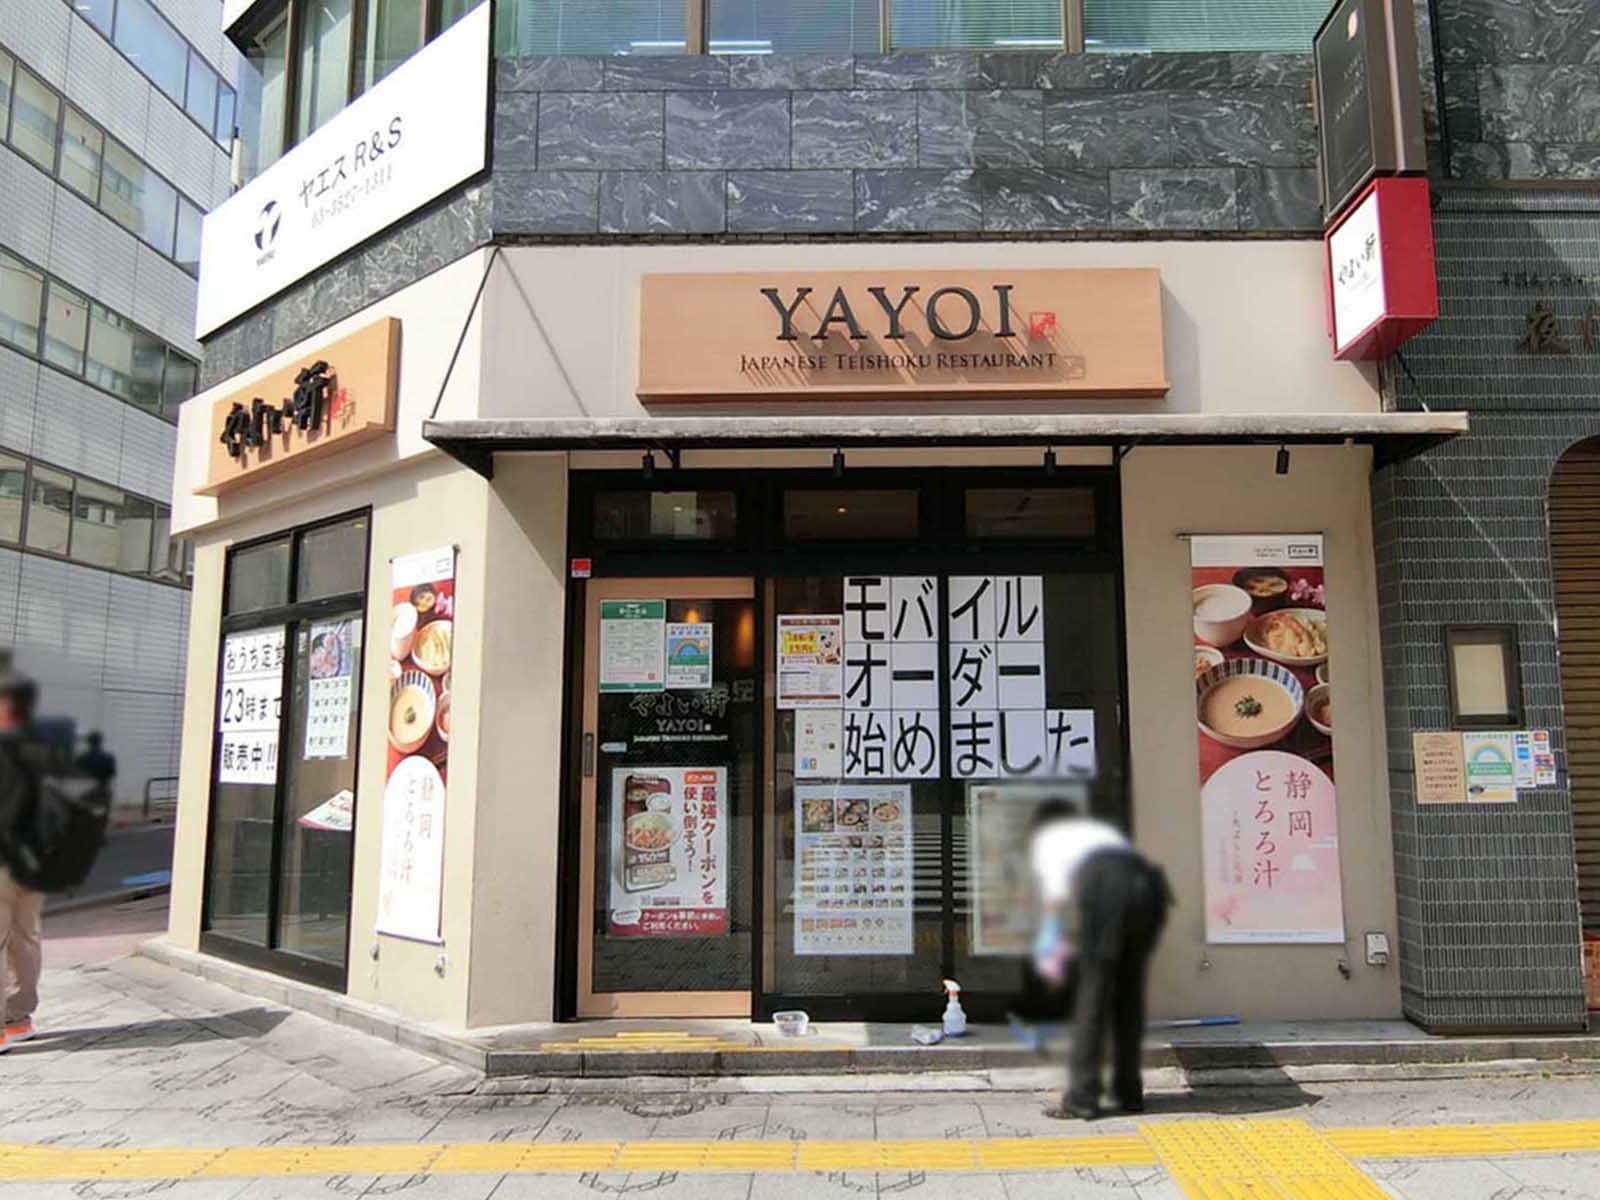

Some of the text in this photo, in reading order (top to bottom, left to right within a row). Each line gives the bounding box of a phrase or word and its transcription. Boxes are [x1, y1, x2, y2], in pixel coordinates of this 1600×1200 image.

[298, 115, 403, 208] ヤエス R&S
[759, 284, 1017, 342] YAYOI
[740, 351, 1058, 374] JAPANESE TEISHOKU RESTAURANT
[845, 577, 1040, 640] モバイル
[845, 643, 1042, 708] オーダー
[655, 719, 704, 732] YAYOI
[845, 711, 1094, 776] 始めました
[1253, 769, 1280, 889] とろろ汁
[1284, 769, 1313, 839] 静岡
[701, 786, 718, 905] 最強クーポンを
